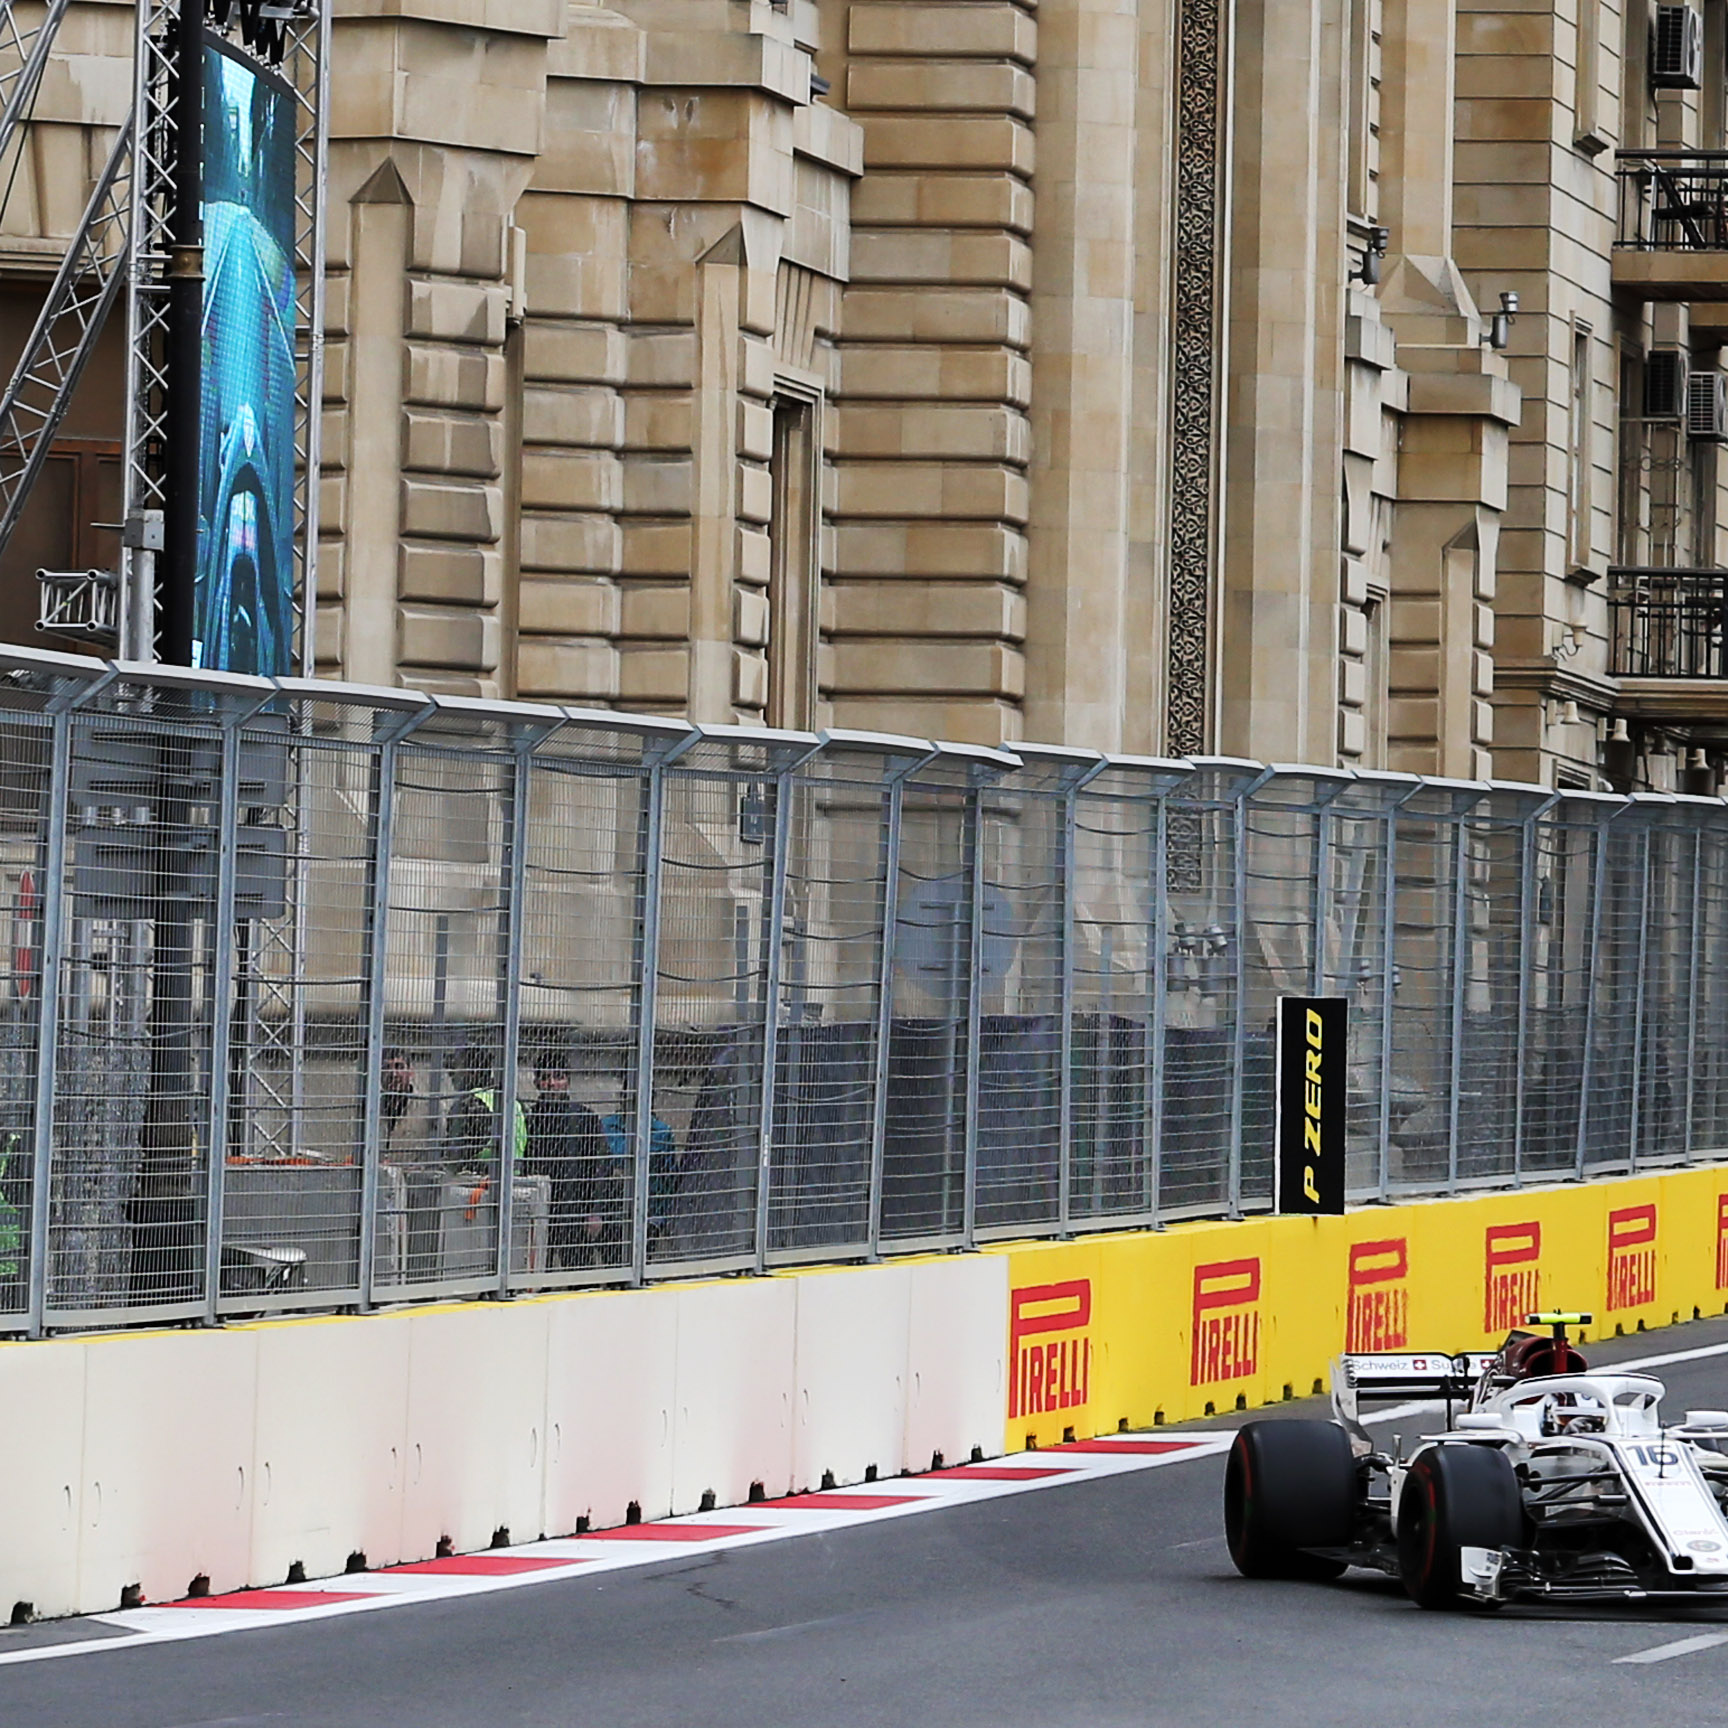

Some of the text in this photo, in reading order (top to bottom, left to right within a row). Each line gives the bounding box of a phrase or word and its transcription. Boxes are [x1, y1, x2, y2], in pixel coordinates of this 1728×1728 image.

[1303, 1008, 1323, 1204] P ZERO
[1346, 1238, 1409, 1353] PIRELLI
[1484, 1221, 1541, 1333] PIRELLI
[1607, 1204, 1656, 1311] PIRELLI
[1008, 1279, 1091, 1419] PIRELLI
[1191, 1258, 1260, 1386] PIRELLI
[1353, 1360, 1408, 1371] Schweiz
[1626, 1445, 1679, 1466] 16
